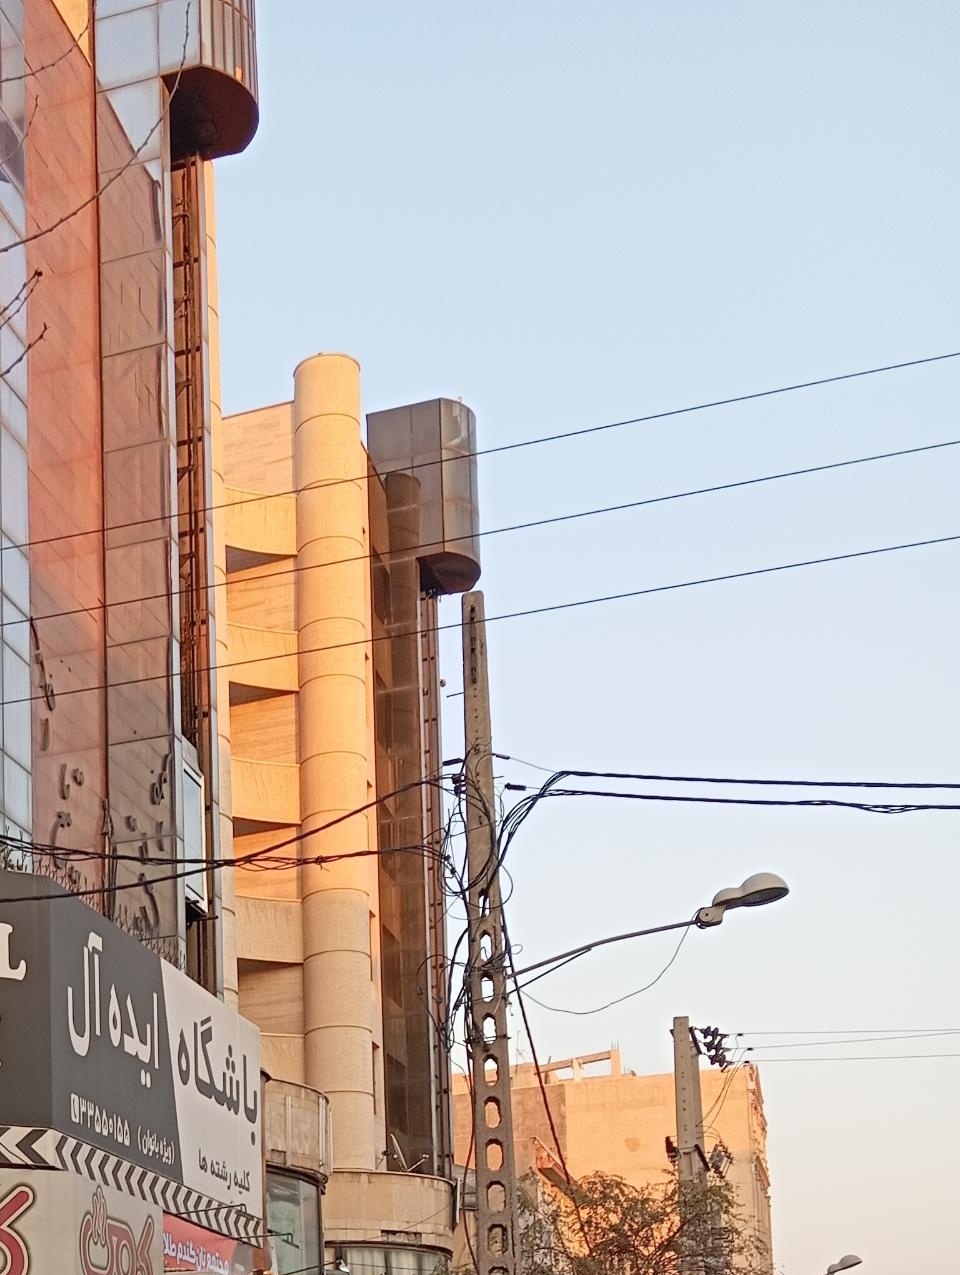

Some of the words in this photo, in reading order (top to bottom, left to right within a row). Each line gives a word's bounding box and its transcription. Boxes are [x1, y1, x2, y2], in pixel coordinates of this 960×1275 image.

[67, 931, 103, 1057] آل
[108, 984, 159, 1089] ایده
[177, 1015, 258, 1146] باشگاه
[198, 1149, 209, 1170] ها
[209, 1160, 233, 1190] رشته
[233, 1172, 251, 1192] کلیه
